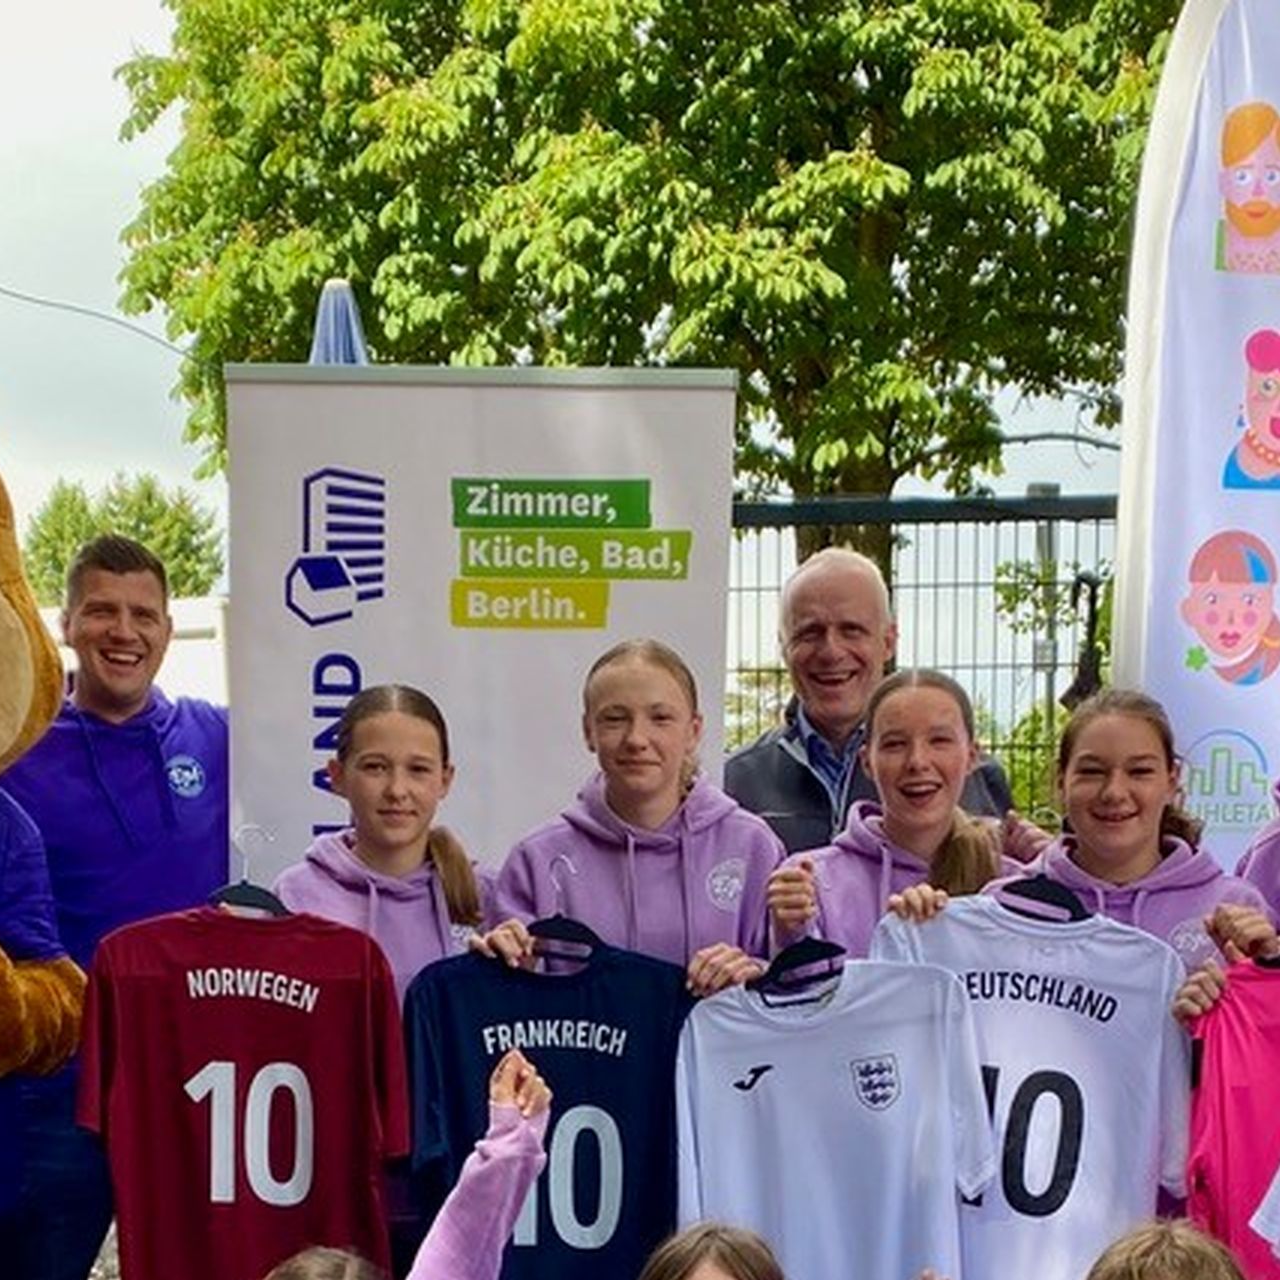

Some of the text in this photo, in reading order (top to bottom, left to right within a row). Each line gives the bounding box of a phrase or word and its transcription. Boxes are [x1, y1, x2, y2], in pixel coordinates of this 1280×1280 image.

[466, 484, 617, 523] Zimmer,
[467, 530, 684, 575] Küche, Bad,
[467, 591, 586, 620] Berlin.
[186, 968, 320, 1012] NORWEGEN
[959, 971, 1118, 1023] EUTSCHLAND
[483, 1019, 627, 1056] FRANKREICH
[184, 1061, 315, 1206] 10
